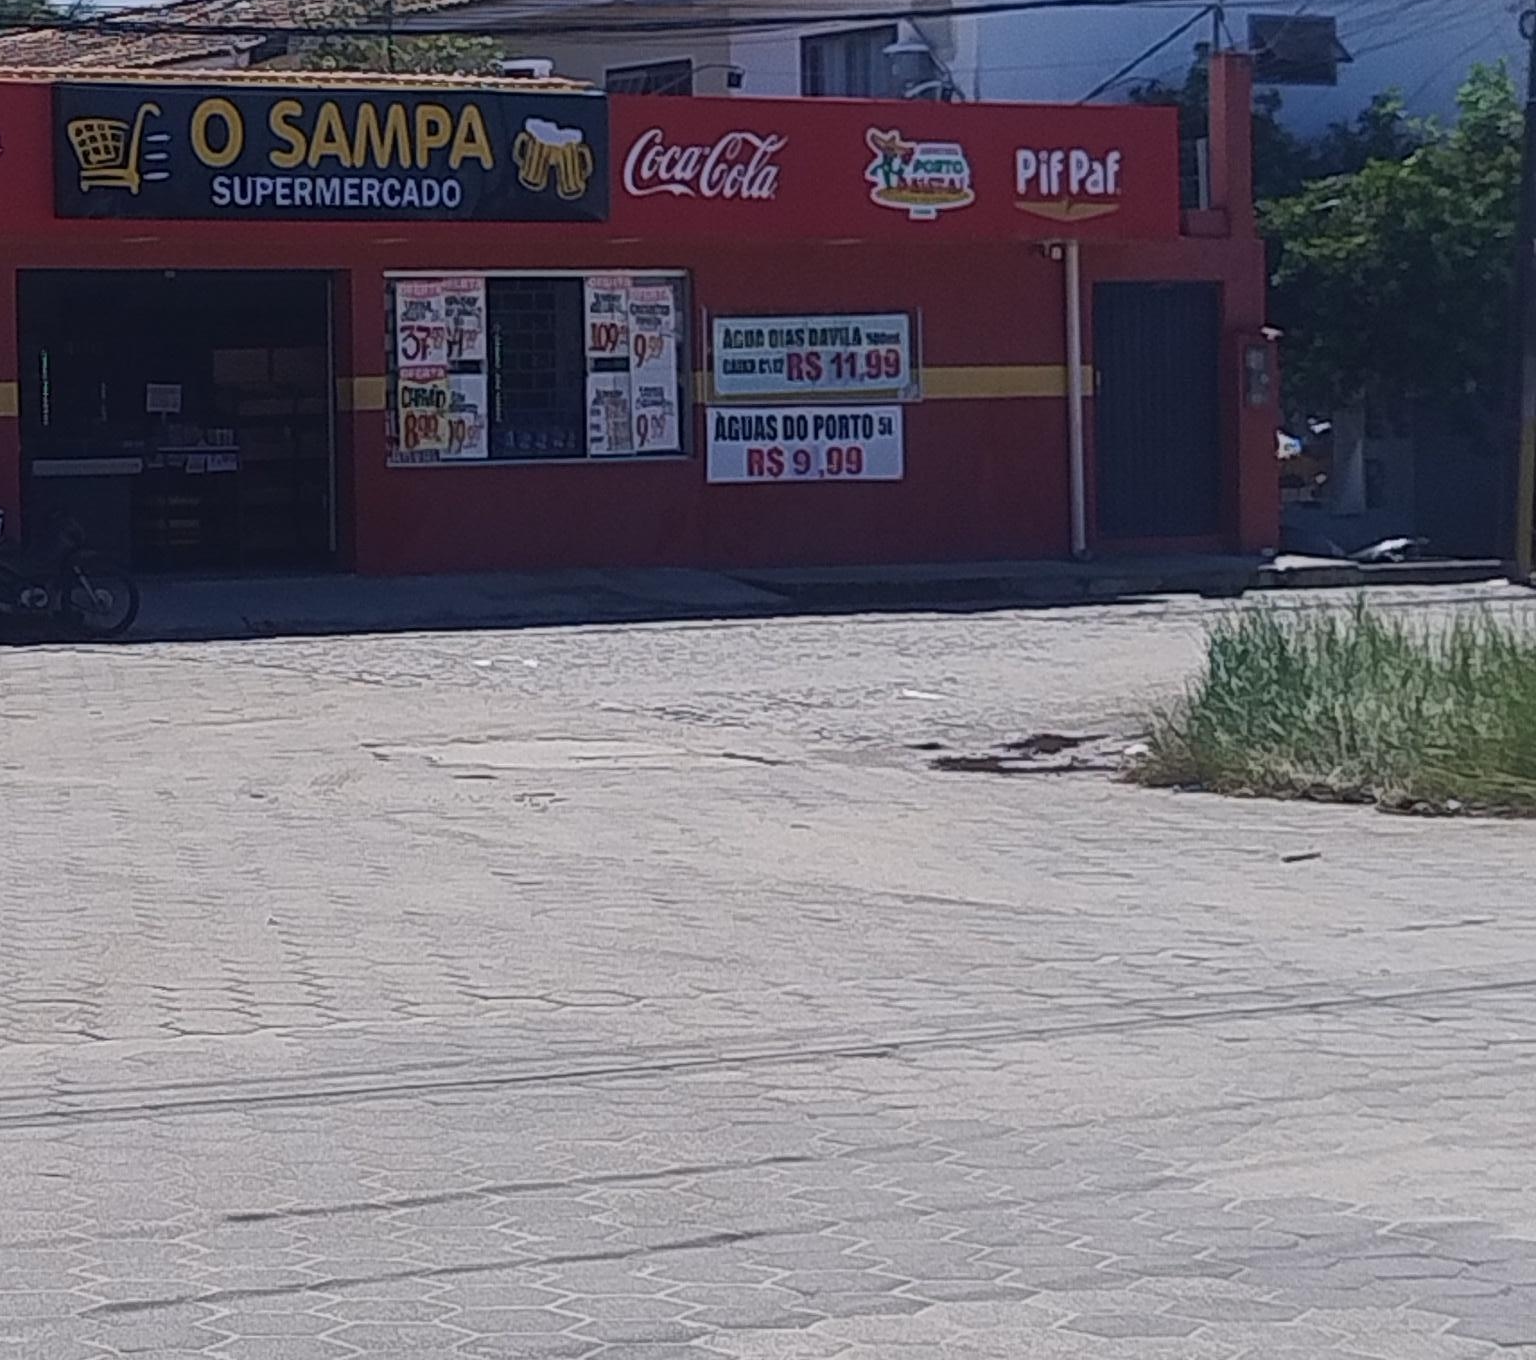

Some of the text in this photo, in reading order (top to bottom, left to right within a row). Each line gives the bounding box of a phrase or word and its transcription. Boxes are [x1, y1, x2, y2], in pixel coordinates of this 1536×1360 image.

[191, 97, 495, 171] O SAMPA
[623, 127, 789, 199] Coca-Cola
[914, 158, 965, 175] PORTO
[211, 175, 462, 208] SUPERMERCADO
[768, 327, 805, 348] DIAS
[786, 350, 824, 382] R$
[782, 414, 809, 441] DO
[813, 413, 874, 441] PORTO
[746, 446, 785, 479] R$
